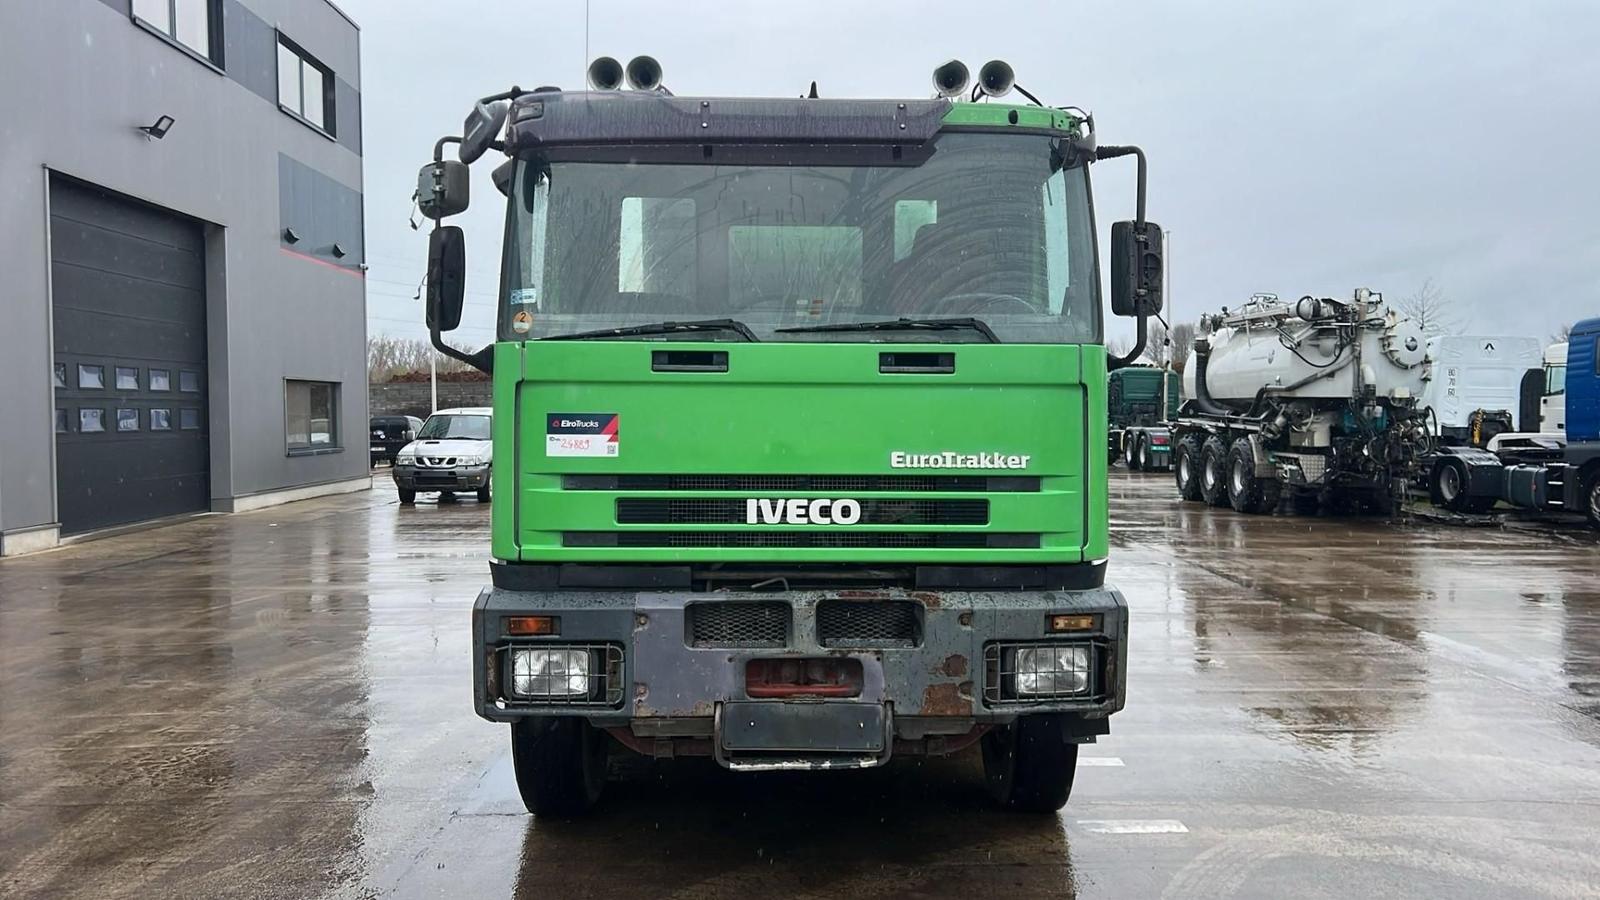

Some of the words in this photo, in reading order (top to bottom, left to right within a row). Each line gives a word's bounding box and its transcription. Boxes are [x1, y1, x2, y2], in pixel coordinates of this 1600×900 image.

[519, 312, 527, 322] 2
[560, 420, 599, 428] ElroTrucks
[890, 451, 1031, 469] EuroTrakker
[746, 498, 861, 525] IVECO
